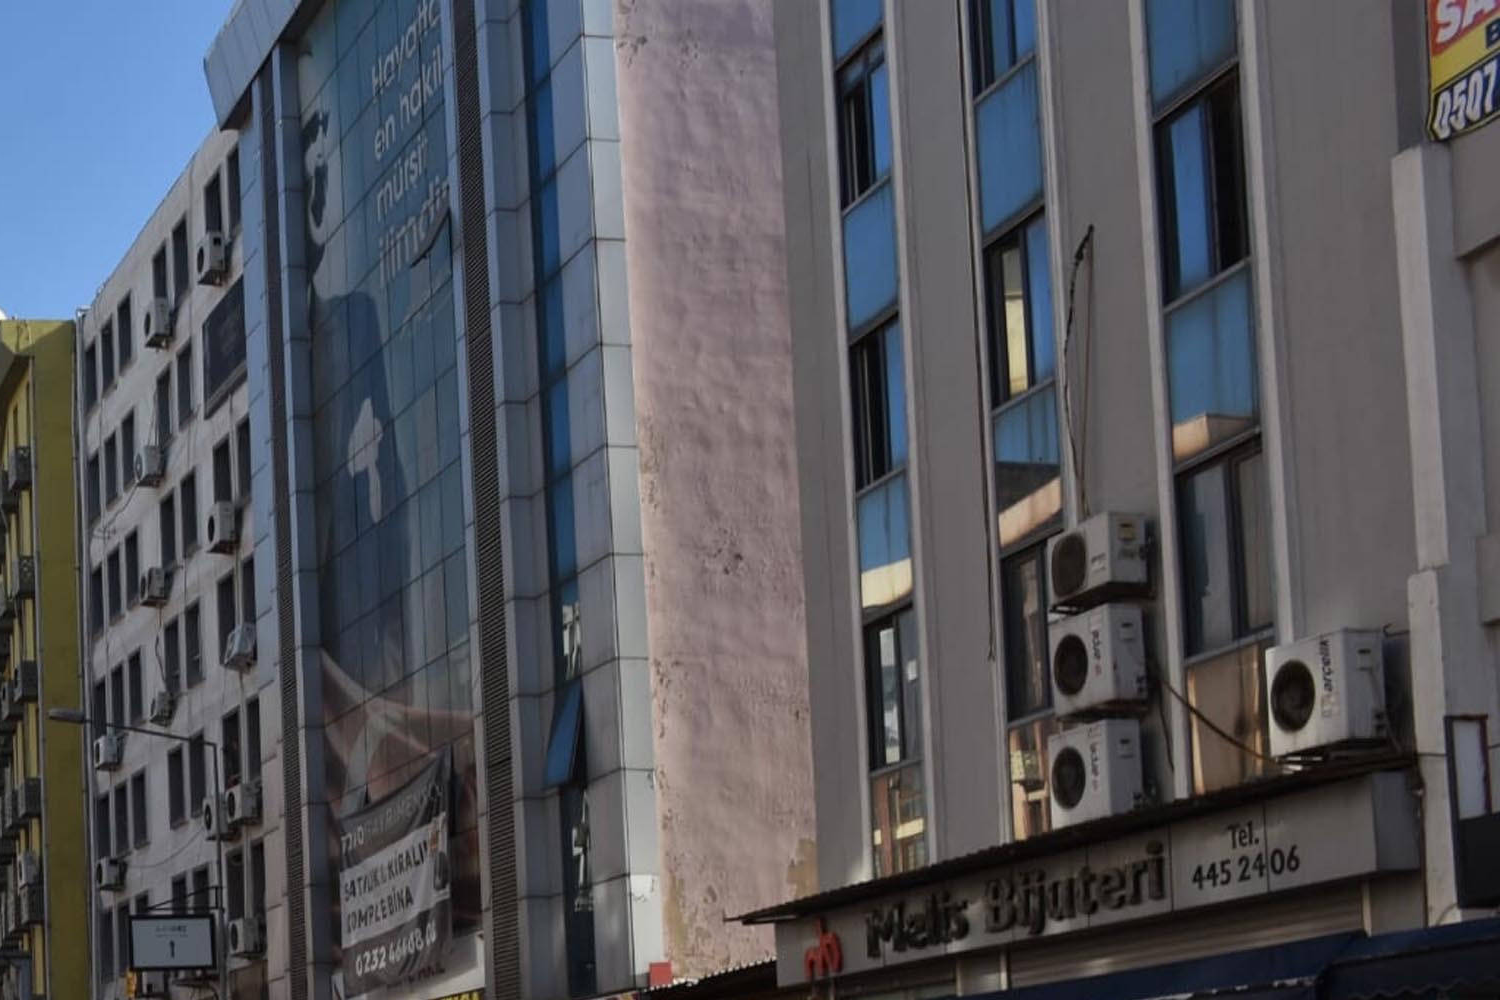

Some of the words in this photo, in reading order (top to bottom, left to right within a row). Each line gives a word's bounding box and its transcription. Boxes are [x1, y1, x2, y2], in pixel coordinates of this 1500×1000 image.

[1433, 58, 1498, 140] 0507
[374, 113, 396, 161] en
[1227, 820, 1259, 849] Tel.
[865, 891, 969, 960] Melis
[984, 841, 1167, 936] Bijuteri
[1192, 858, 1231, 890] 445
[1238, 852, 1266, 883] 24
[1270, 845, 1300, 875] 06
[356, 945, 387, 977] 0232
